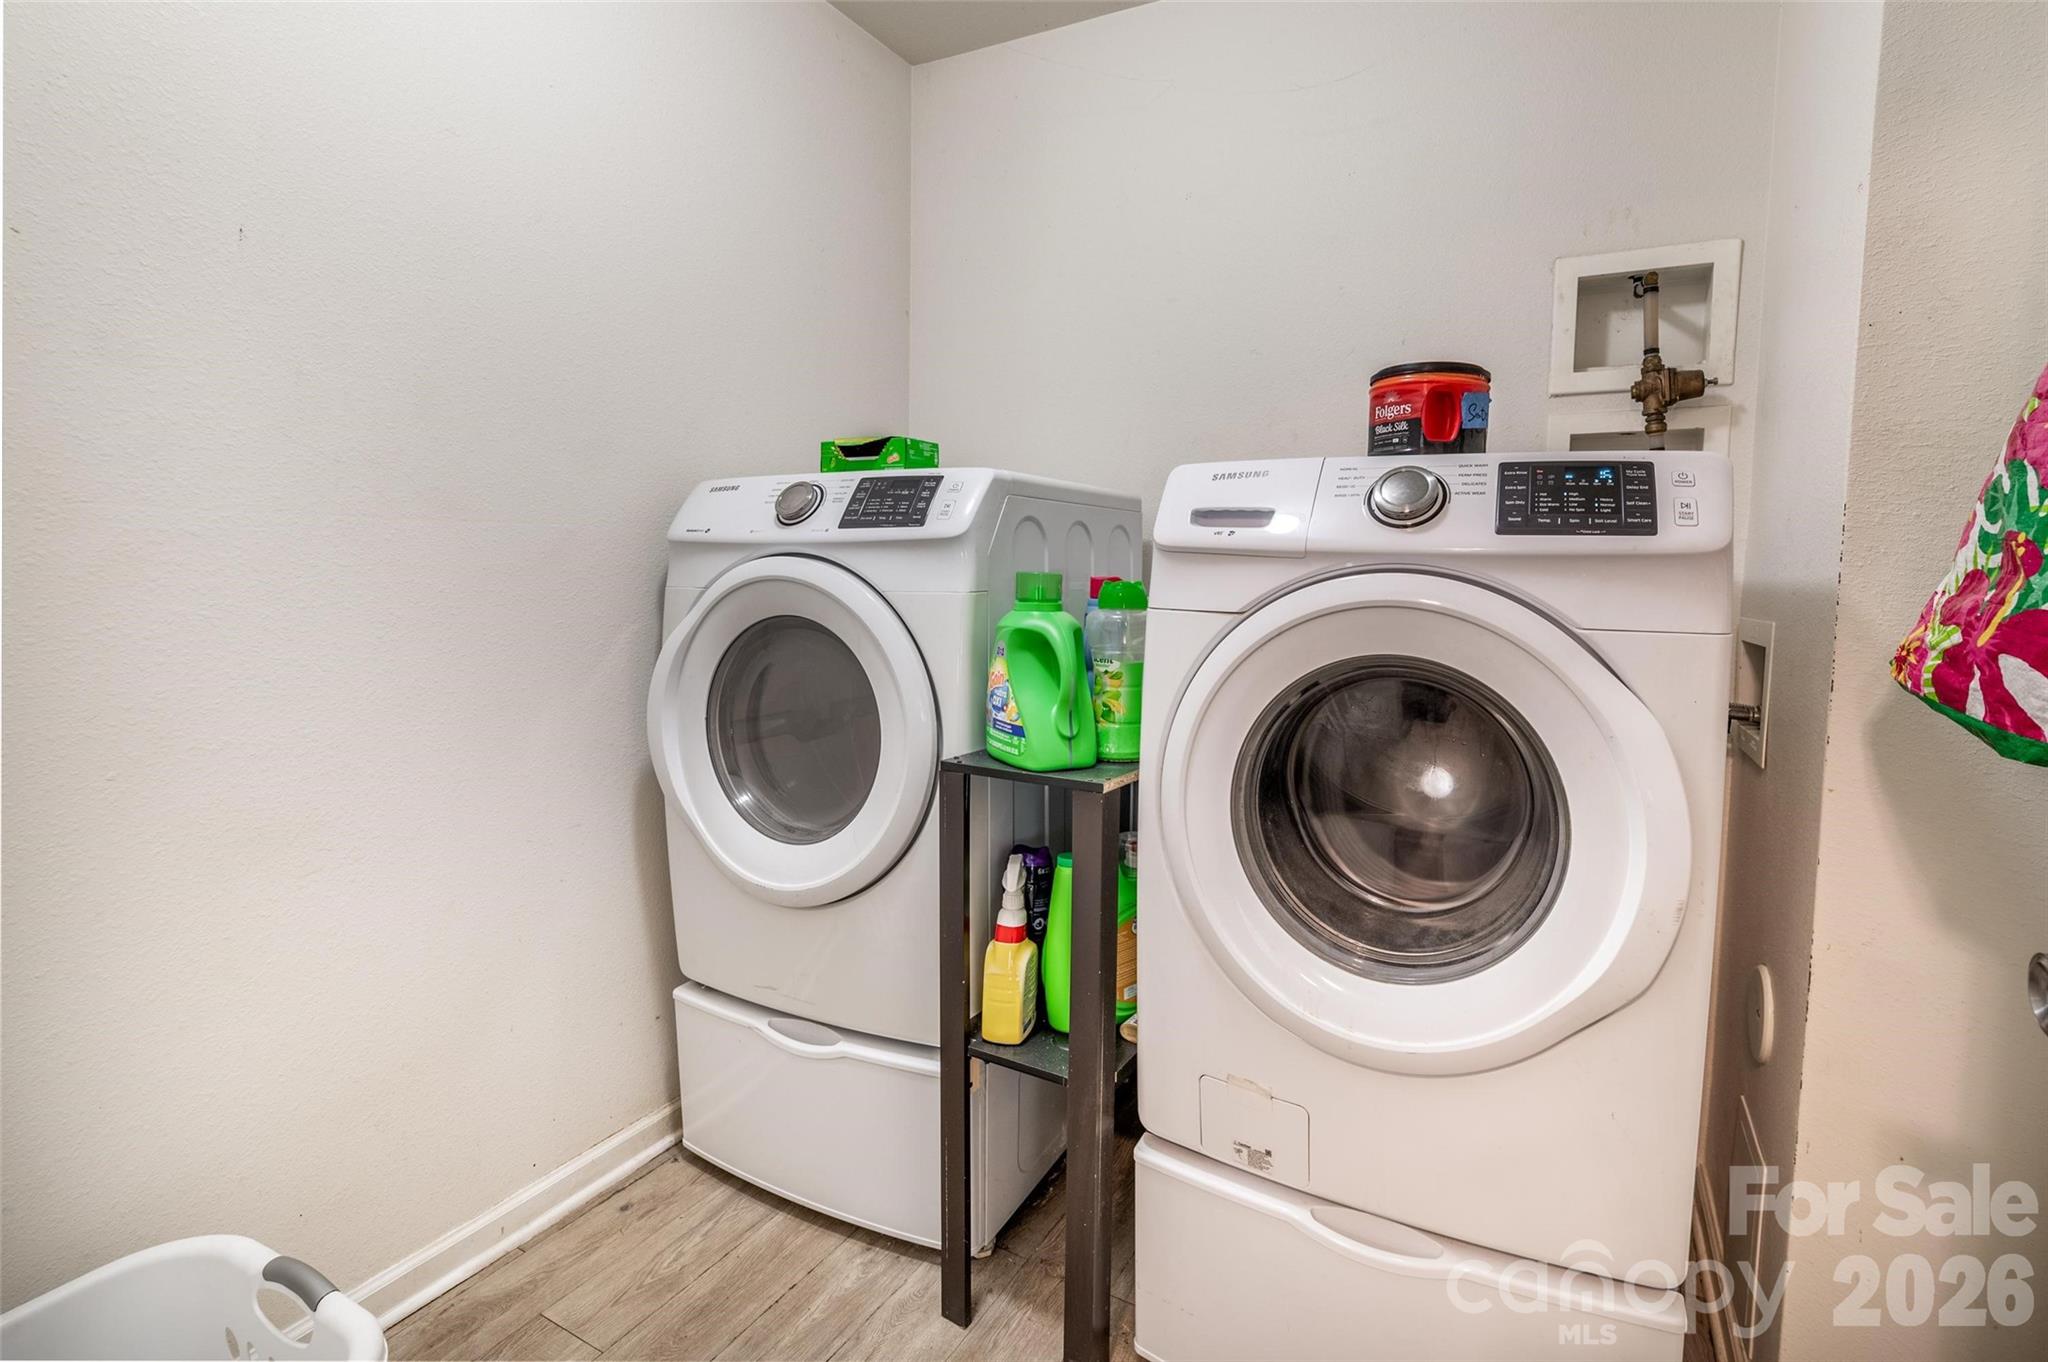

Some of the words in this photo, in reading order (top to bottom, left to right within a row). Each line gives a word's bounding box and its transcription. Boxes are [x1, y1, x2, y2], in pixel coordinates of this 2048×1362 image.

[1375, 403, 1411, 420] Folgers
[1375, 424, 1392, 434] Black
[1393, 421, 1409, 432] Silk
[1212, 470, 1269, 481] SAMSUNG
